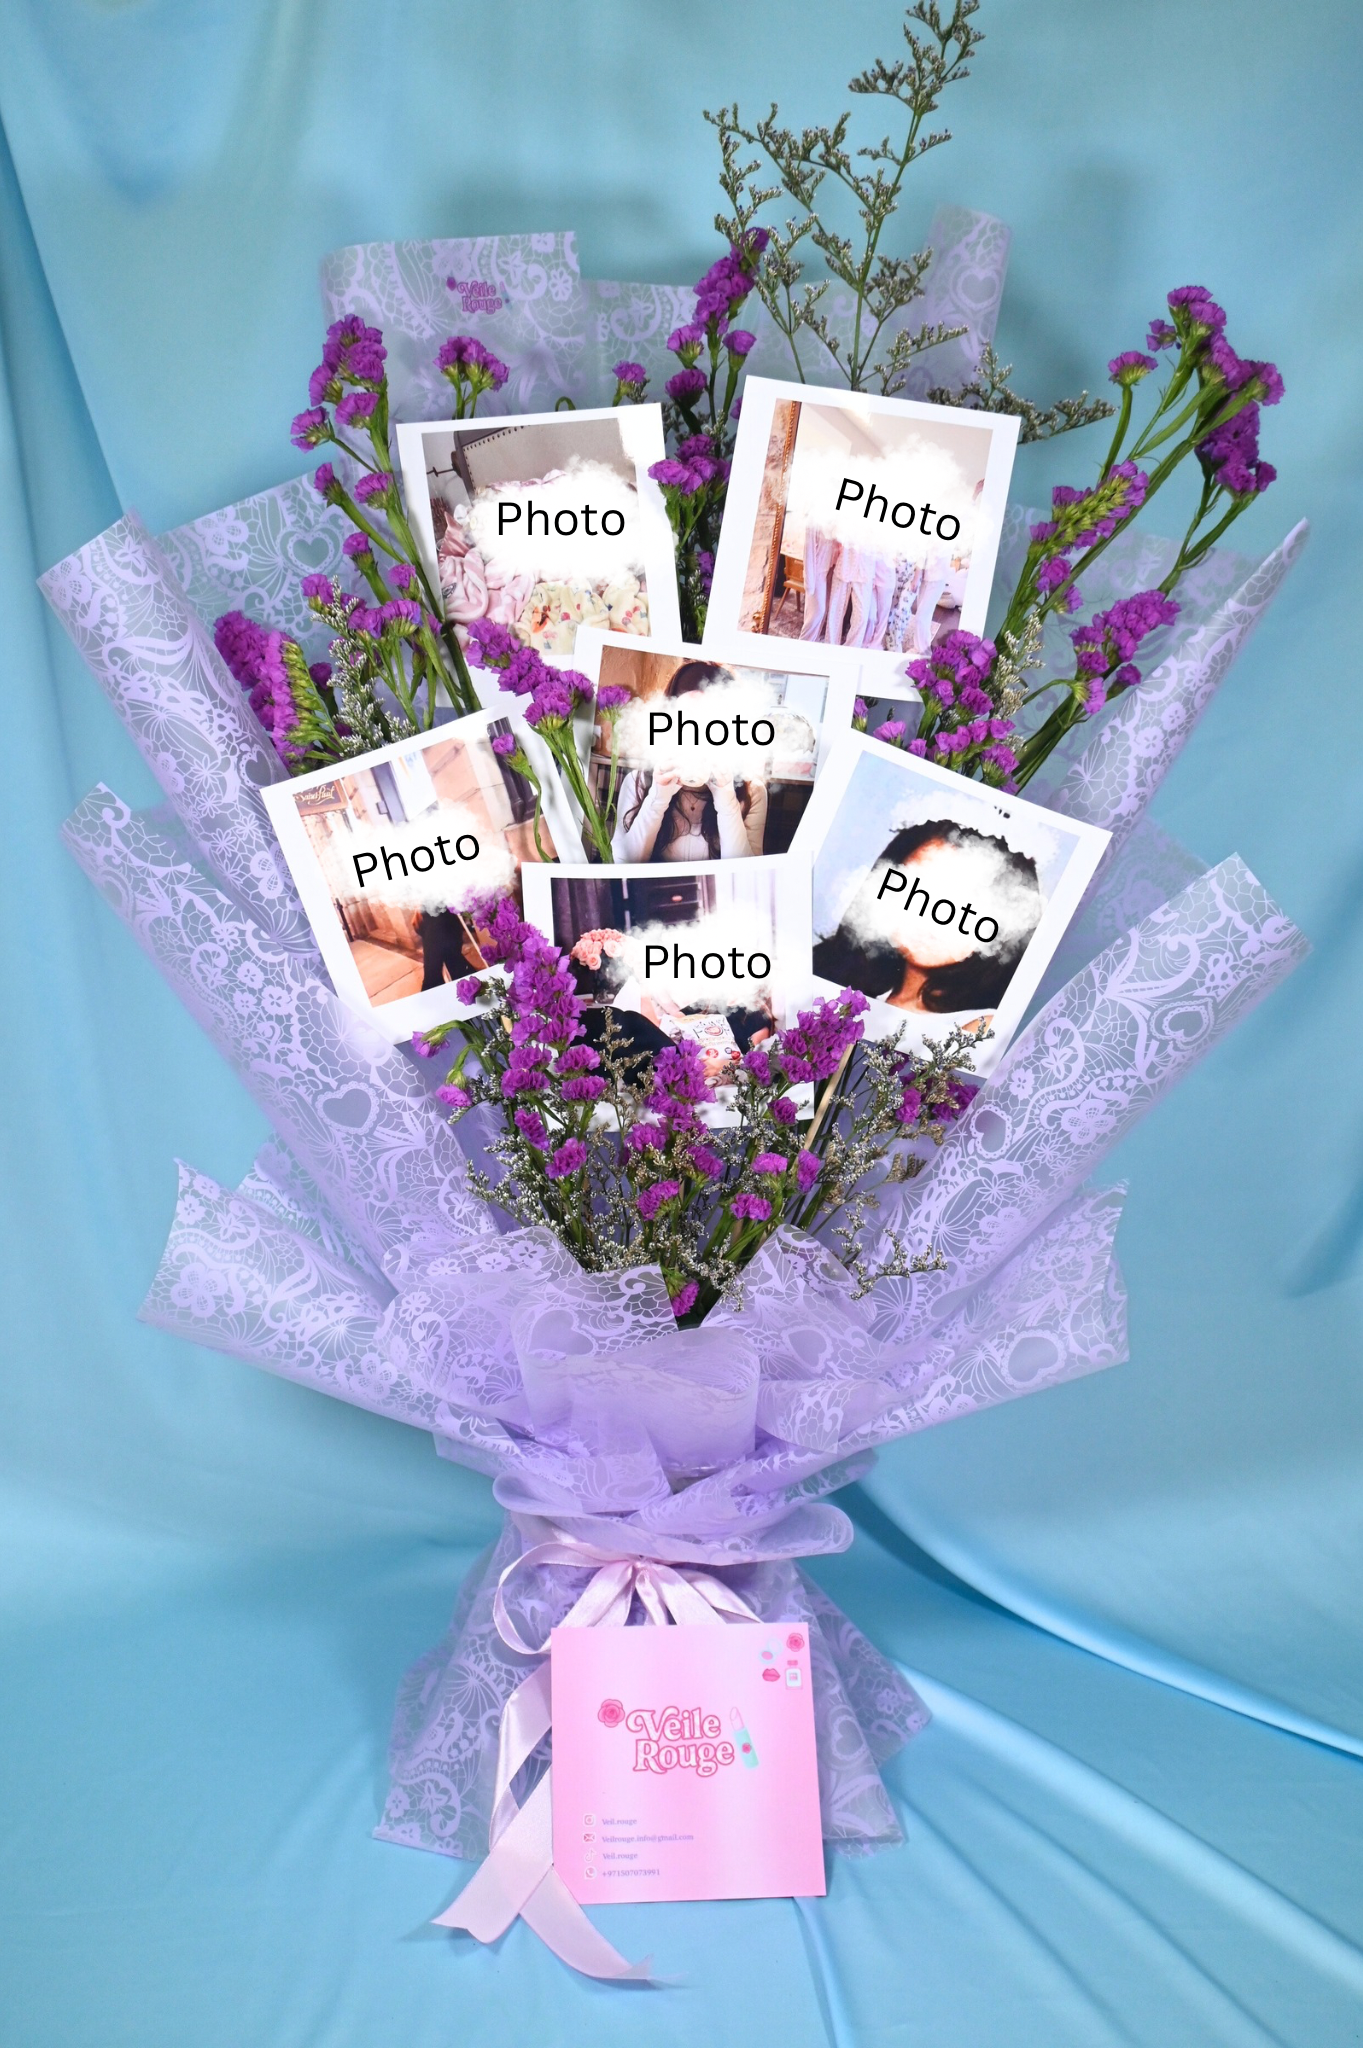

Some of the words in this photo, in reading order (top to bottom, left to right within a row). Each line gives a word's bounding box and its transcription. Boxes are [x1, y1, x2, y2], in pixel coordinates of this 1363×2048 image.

[456, 280, 496, 298] Veile
[462, 296, 503, 315] Rouge
[625, 1705, 721, 1741] Veile
[632, 1738, 735, 1778] Rouge
[602, 1818, 637, 1826] Veil.rouge
[602, 1852, 638, 1860] Veil.rouge
